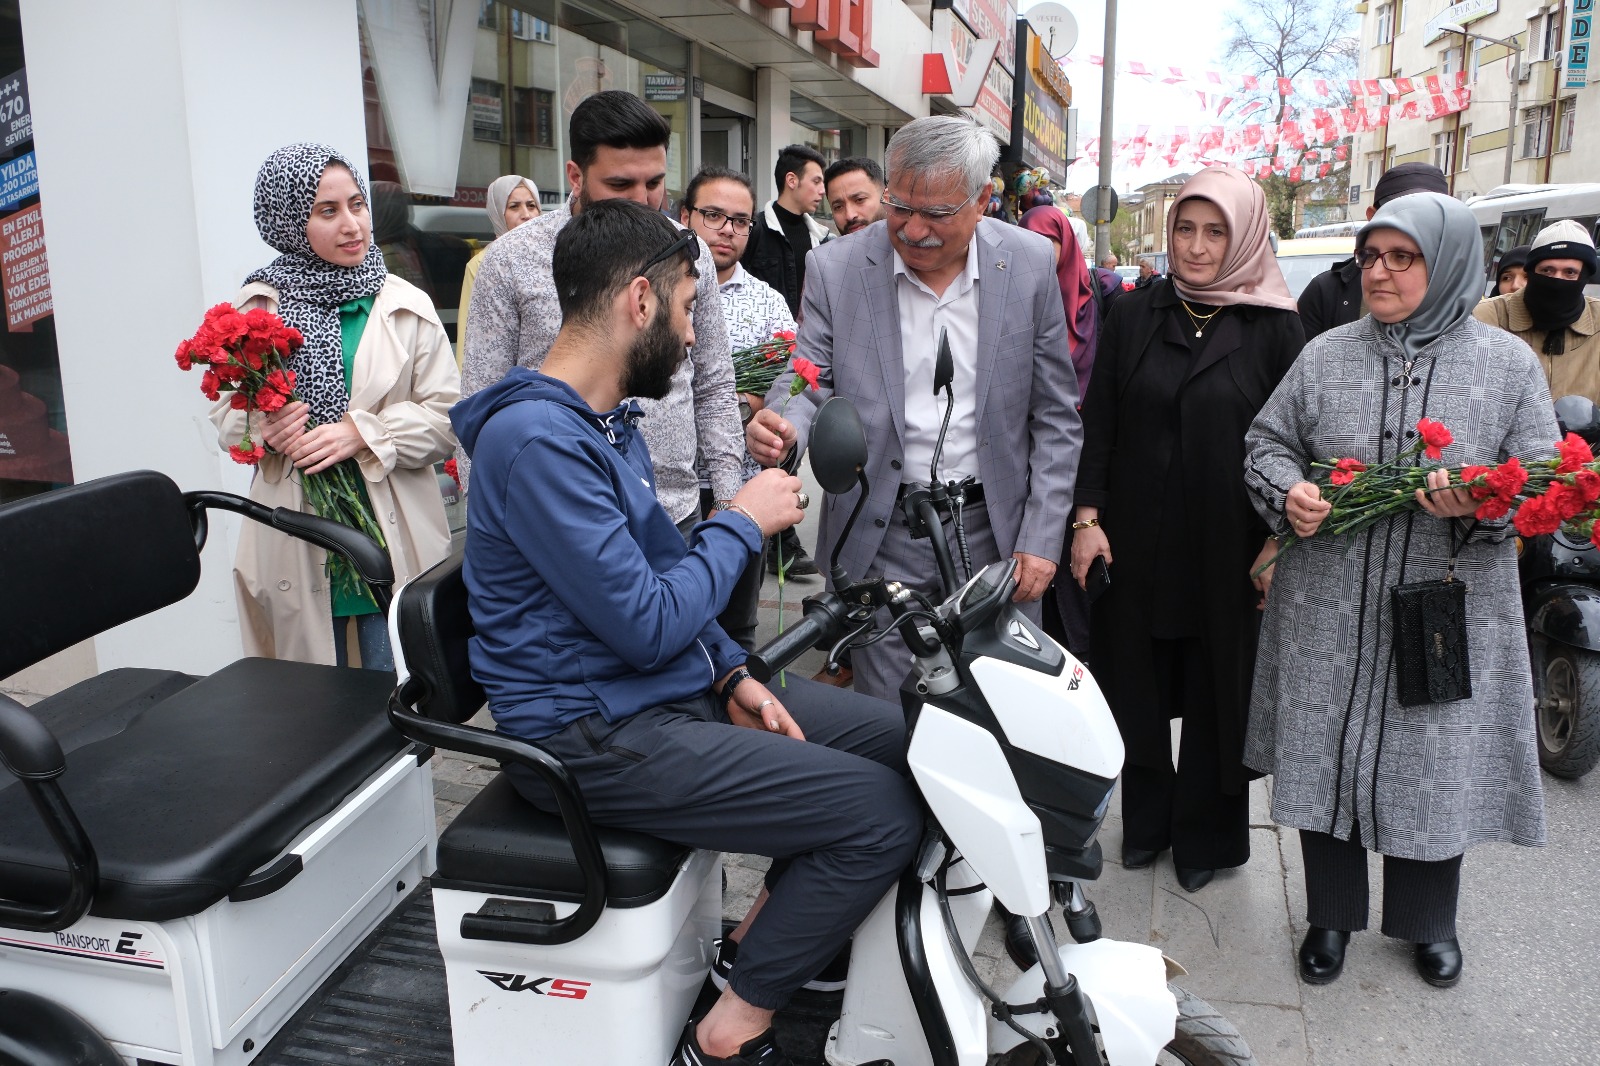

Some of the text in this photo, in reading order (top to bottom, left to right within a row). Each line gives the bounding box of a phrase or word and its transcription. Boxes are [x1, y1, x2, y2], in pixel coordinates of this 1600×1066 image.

[1023, 90, 1067, 161] ZÜCCACİYE
[1, 155, 35, 181] YILDA
[2, 220, 15, 236] EN
[10, 224, 40, 247] ALERJİ
[7, 267, 11, 277] 7
[12, 255, 40, 275] ALERJEN
[10, 275, 15, 284] 4
[7, 281, 27, 300] YOK
[10, 310, 24, 325] İLK
[54, 932, 110, 952] TRANSPORT
[475, 969, 592, 1000] RKS
